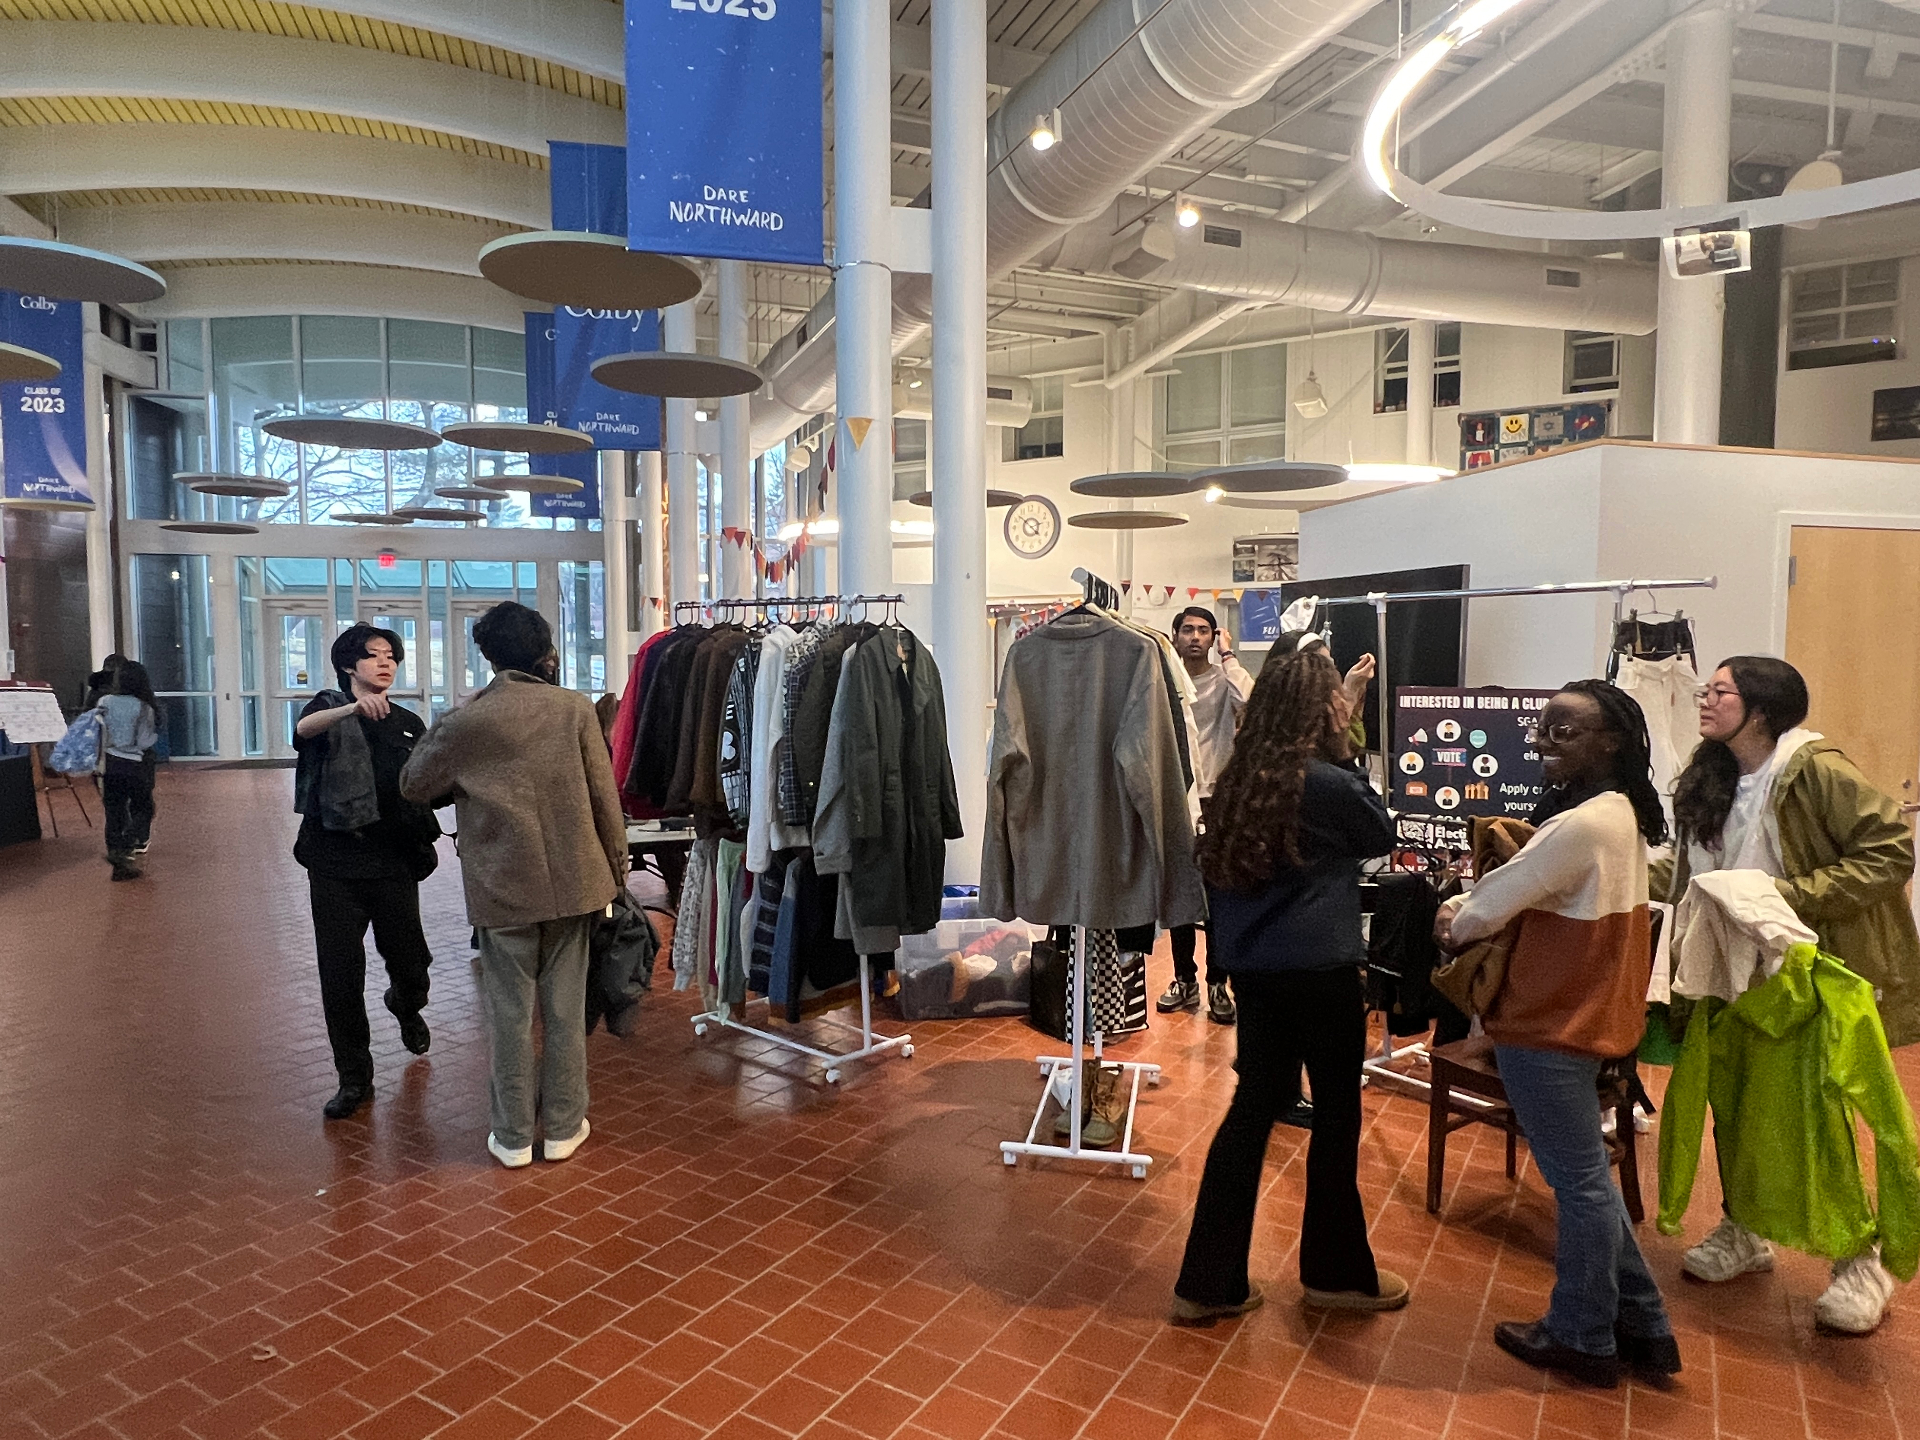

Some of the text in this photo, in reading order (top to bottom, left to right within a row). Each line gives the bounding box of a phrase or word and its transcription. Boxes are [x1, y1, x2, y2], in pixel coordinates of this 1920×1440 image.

[704, 185, 749, 204] DARE
[669, 200, 784, 231] NORTHWARD
[20, 295, 58, 315] Colby
[20, 396, 66, 413] 2023
[595, 412, 621, 421] DARE
[578, 421, 640, 435] NORTHWARD
[1399, 695, 1460, 709] INTERESTED
[1462, 696, 1475, 709] IN
[1477, 696, 1509, 710] BEING
[1511, 697, 1520, 710] A
[1437, 751, 1462, 763] VOTE
[1499, 782, 1530, 796] Apply
[1504, 801, 1538, 813] yours
[1435, 825, 1468, 839] Electi
